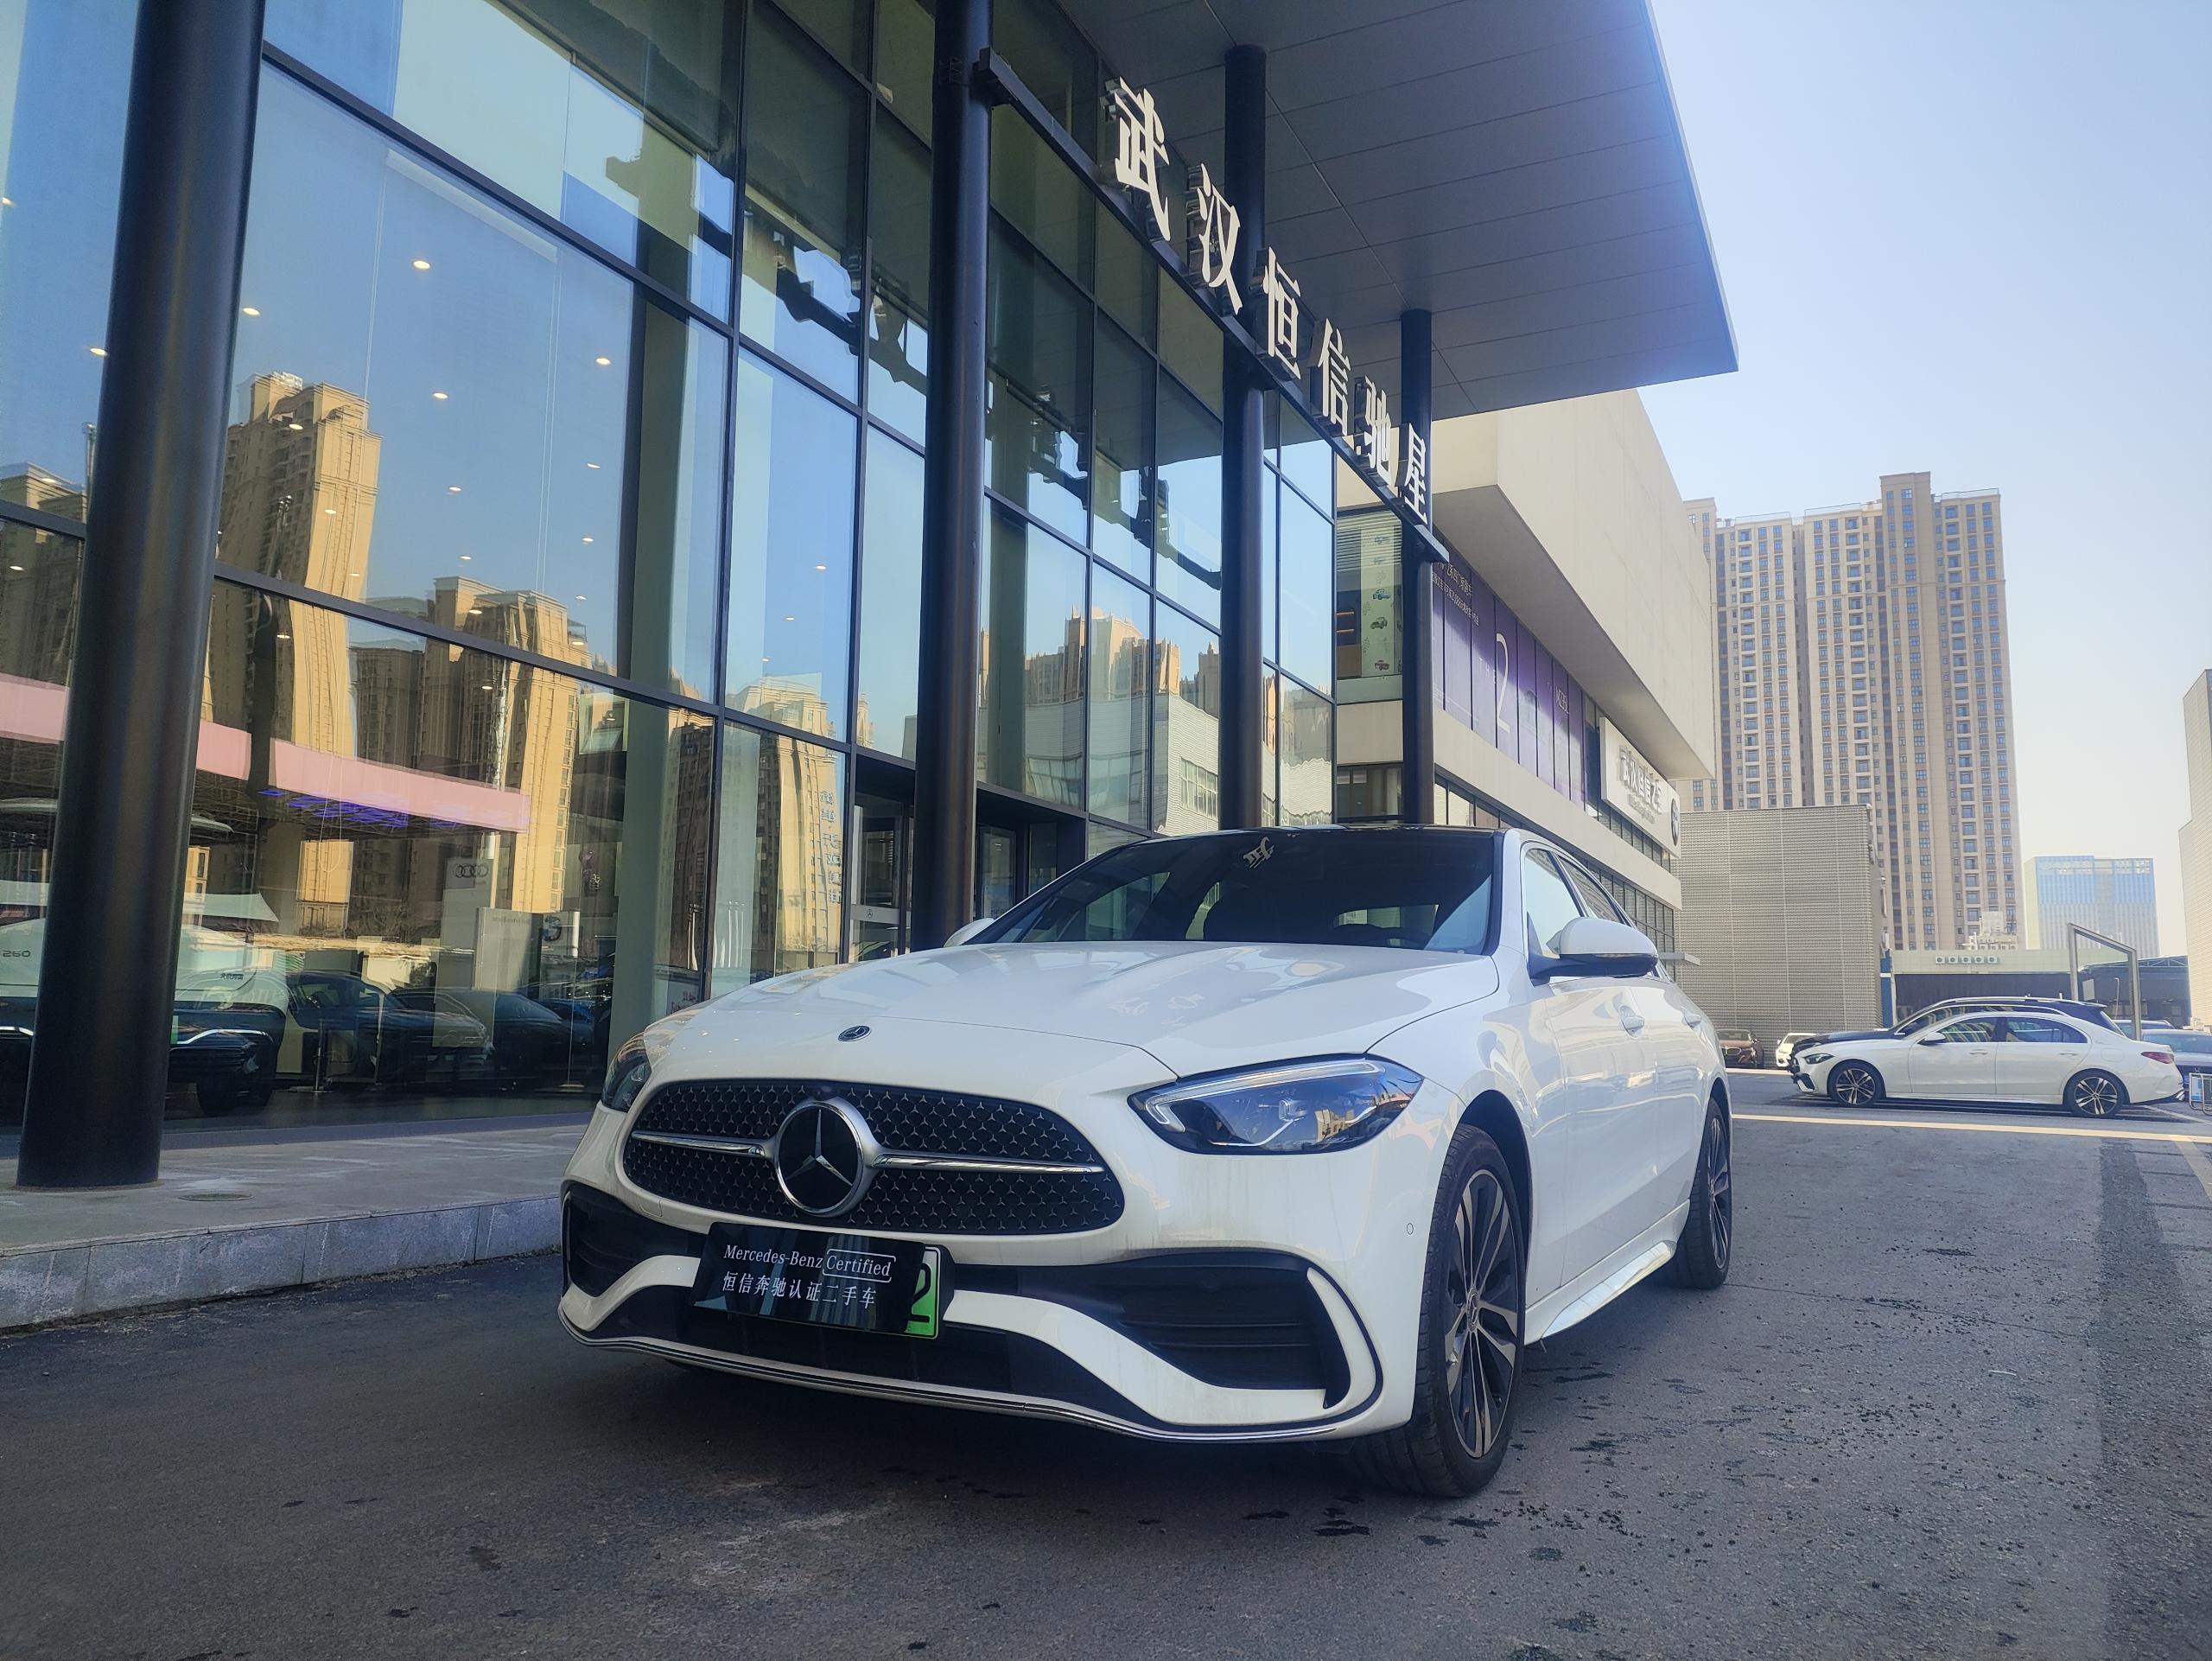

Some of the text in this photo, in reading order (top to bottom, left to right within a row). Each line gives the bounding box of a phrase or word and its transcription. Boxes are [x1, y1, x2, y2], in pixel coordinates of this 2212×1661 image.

[1114, 76, 1429, 525] 武汉恒信驰星
[1496, 633, 1510, 734] 2
[721, 1270, 877, 1309] 恒信奔驰认证二手车
[722, 1244, 892, 1276] Mercedes-Benz Certified
